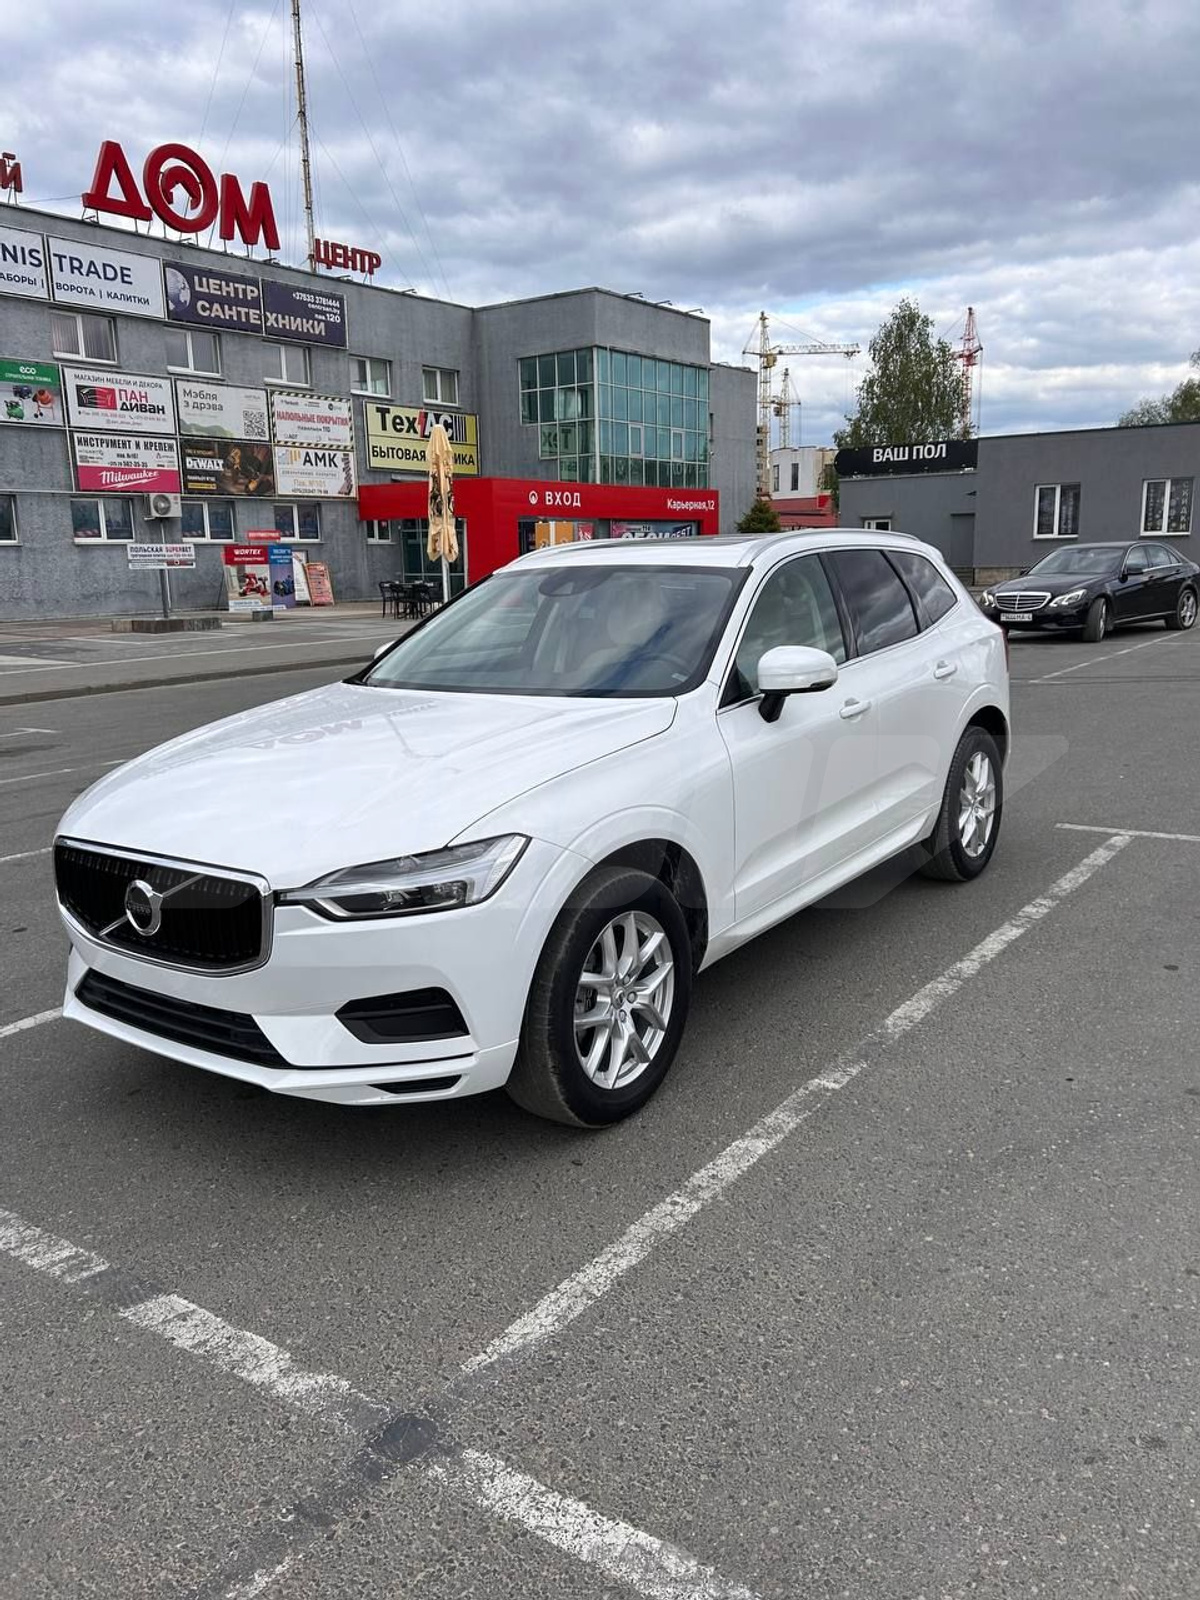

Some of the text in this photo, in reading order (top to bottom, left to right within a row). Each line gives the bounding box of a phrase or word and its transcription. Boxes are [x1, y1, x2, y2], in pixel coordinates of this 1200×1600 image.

[82, 139, 280, 251] ДОМ
[0, 243, 133, 285] NIS TRADE
[313, 238, 381, 275] ЦЕНТР
[55, 281, 150, 306] ВОРОТА КАЛИТКИ
[194, 275, 259, 300] ЦЕНТР
[326, 313, 341, 323] 120
[74, 373, 104, 383] МАГАЗИН
[106, 377, 131, 386] МЕБЕЛИ
[139, 381, 163, 390] ДЕКОРА
[119, 389, 149, 403] ПАН
[183, 388, 218, 401] Мэбля
[192, 401, 224, 412] дрэва
[77, 435, 131, 450] ИНСТРУМЕНТ
[135, 440, 141, 450] И
[144, 440, 175, 453] КРЕПЕЖ
[303, 450, 339, 468] АМК
[371, 445, 426, 462] БЫТОВАЯ
[873, 443, 946, 463] ВАШ ПОЛ
[98, 470, 160, 484] Milwaukee
[545, 491, 581, 507] ВХОД
